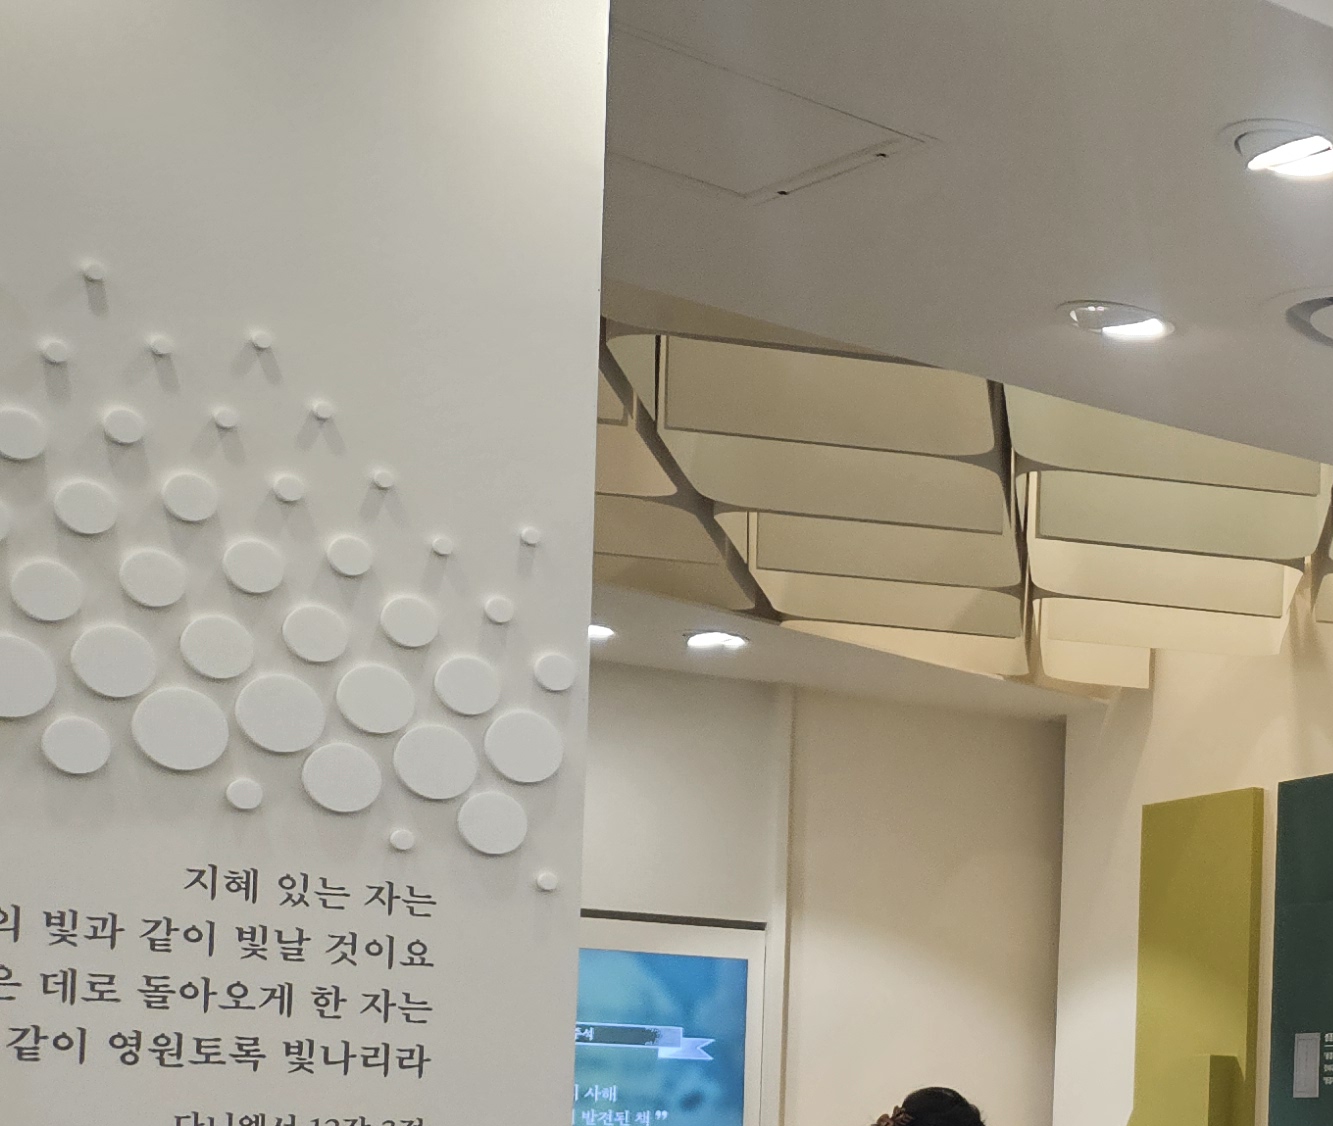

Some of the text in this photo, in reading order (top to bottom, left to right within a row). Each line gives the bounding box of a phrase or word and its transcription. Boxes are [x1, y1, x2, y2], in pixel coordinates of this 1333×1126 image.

[183, 863, 437, 918] 지혜 있는 자는
[42, 909, 125, 949] 빛과
[139, 916, 216, 957] 같이
[235, 924, 312, 962] 빛날
[325, 932, 435, 969] 것이요
[39, 968, 122, 1005] 데로
[137, 975, 293, 1017] 돌아오게
[310, 985, 348, 1020] 한
[360, 988, 433, 1024] 자는
[5, 1024, 432, 1078] 같이 영원토록 빛나리라
[582, 1109, 630, 1126] 발견된
[584, 1084, 617, 1102] 사해
